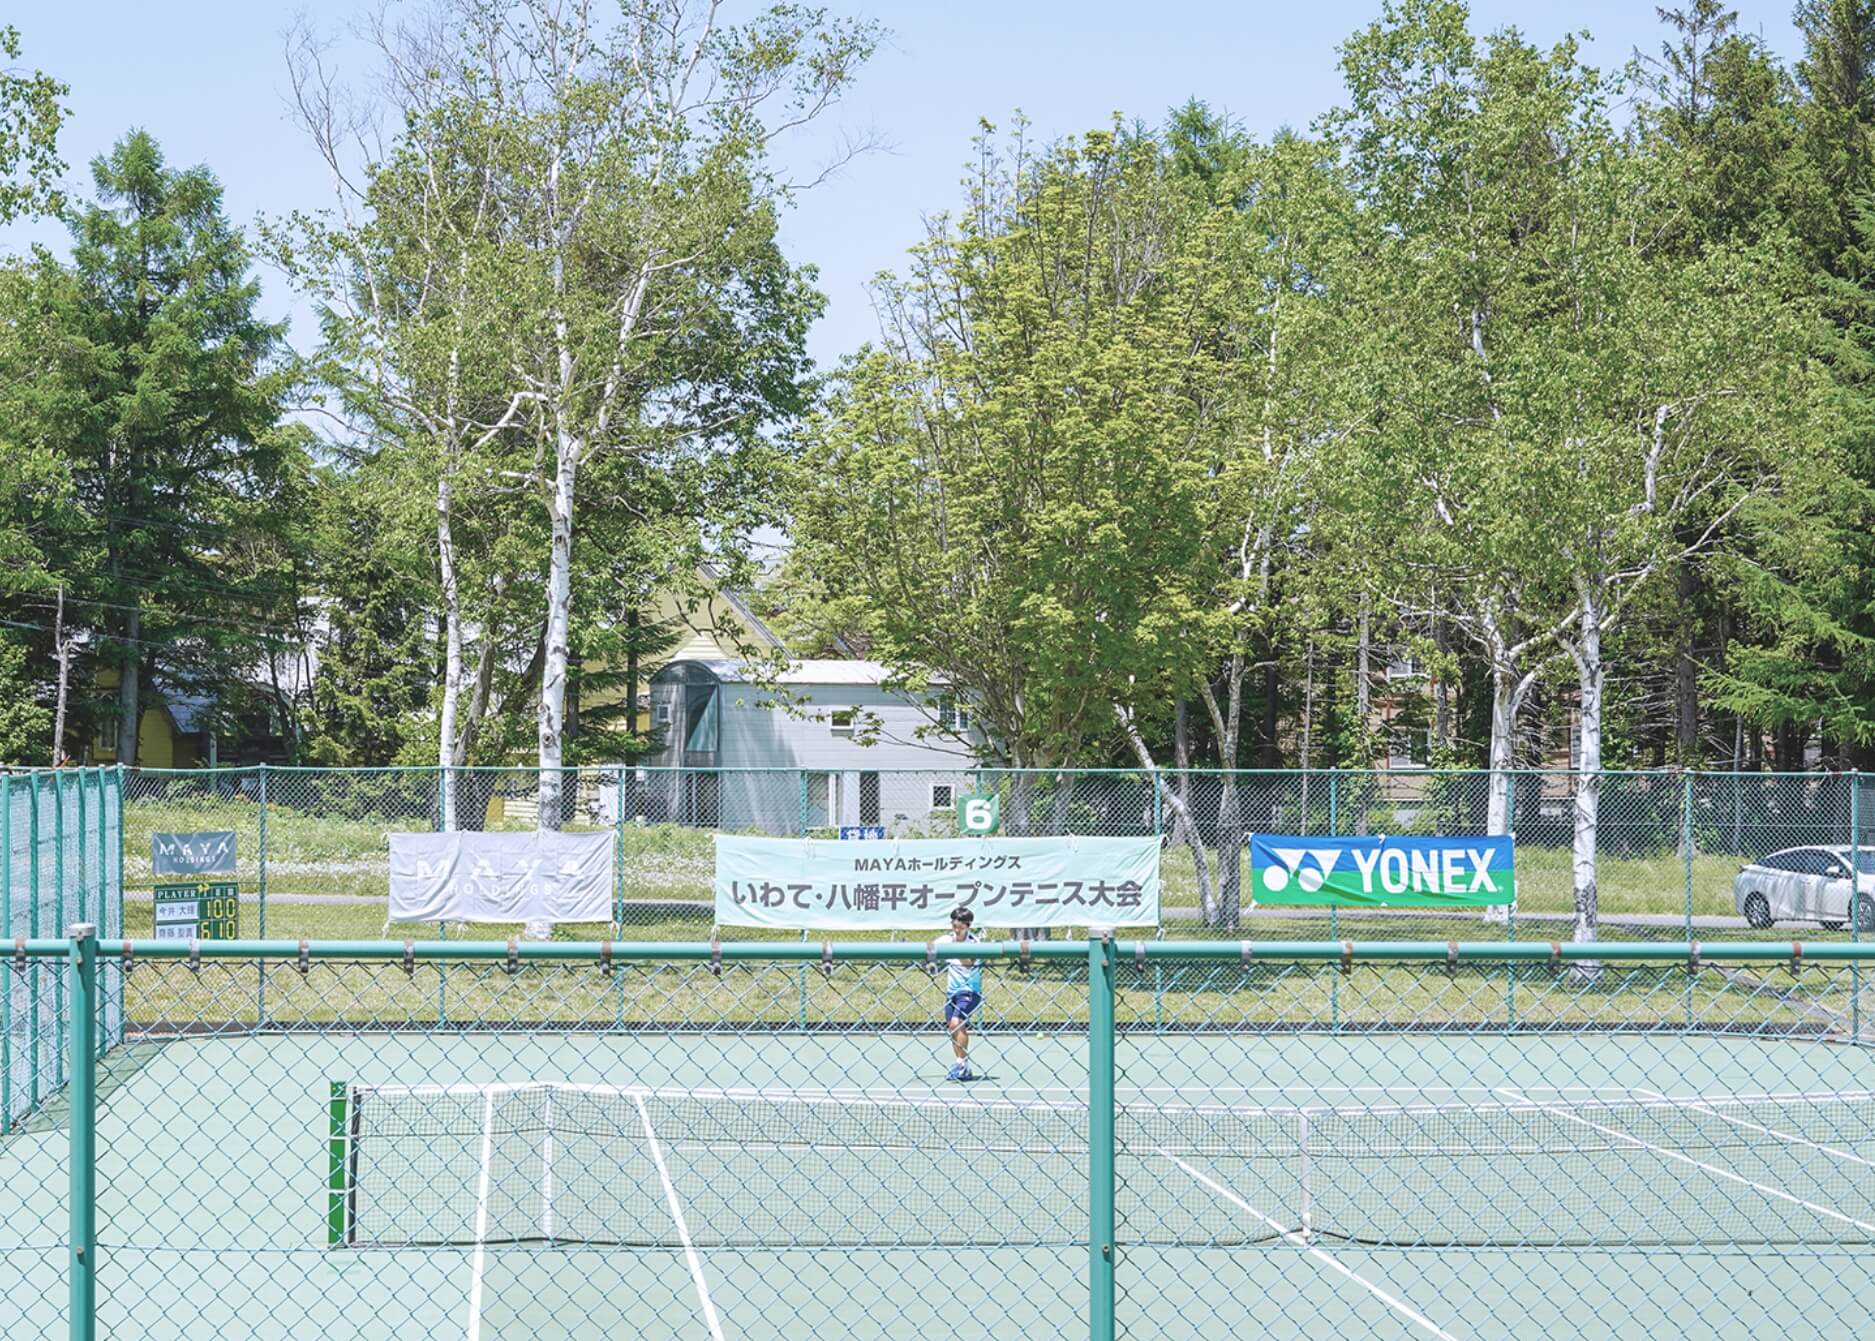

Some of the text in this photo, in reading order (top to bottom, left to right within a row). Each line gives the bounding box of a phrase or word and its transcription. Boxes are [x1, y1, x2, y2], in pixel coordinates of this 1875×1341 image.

[965, 799, 992, 830] 6
[160, 841, 229, 856] MAYA
[854, 856, 1021, 872] MAYAホールディングス
[1351, 848, 1497, 894] YONEX
[158, 889, 196, 899] PLAYER
[731, 880, 1143, 912] いわて・八幡平オープンテニス大会
